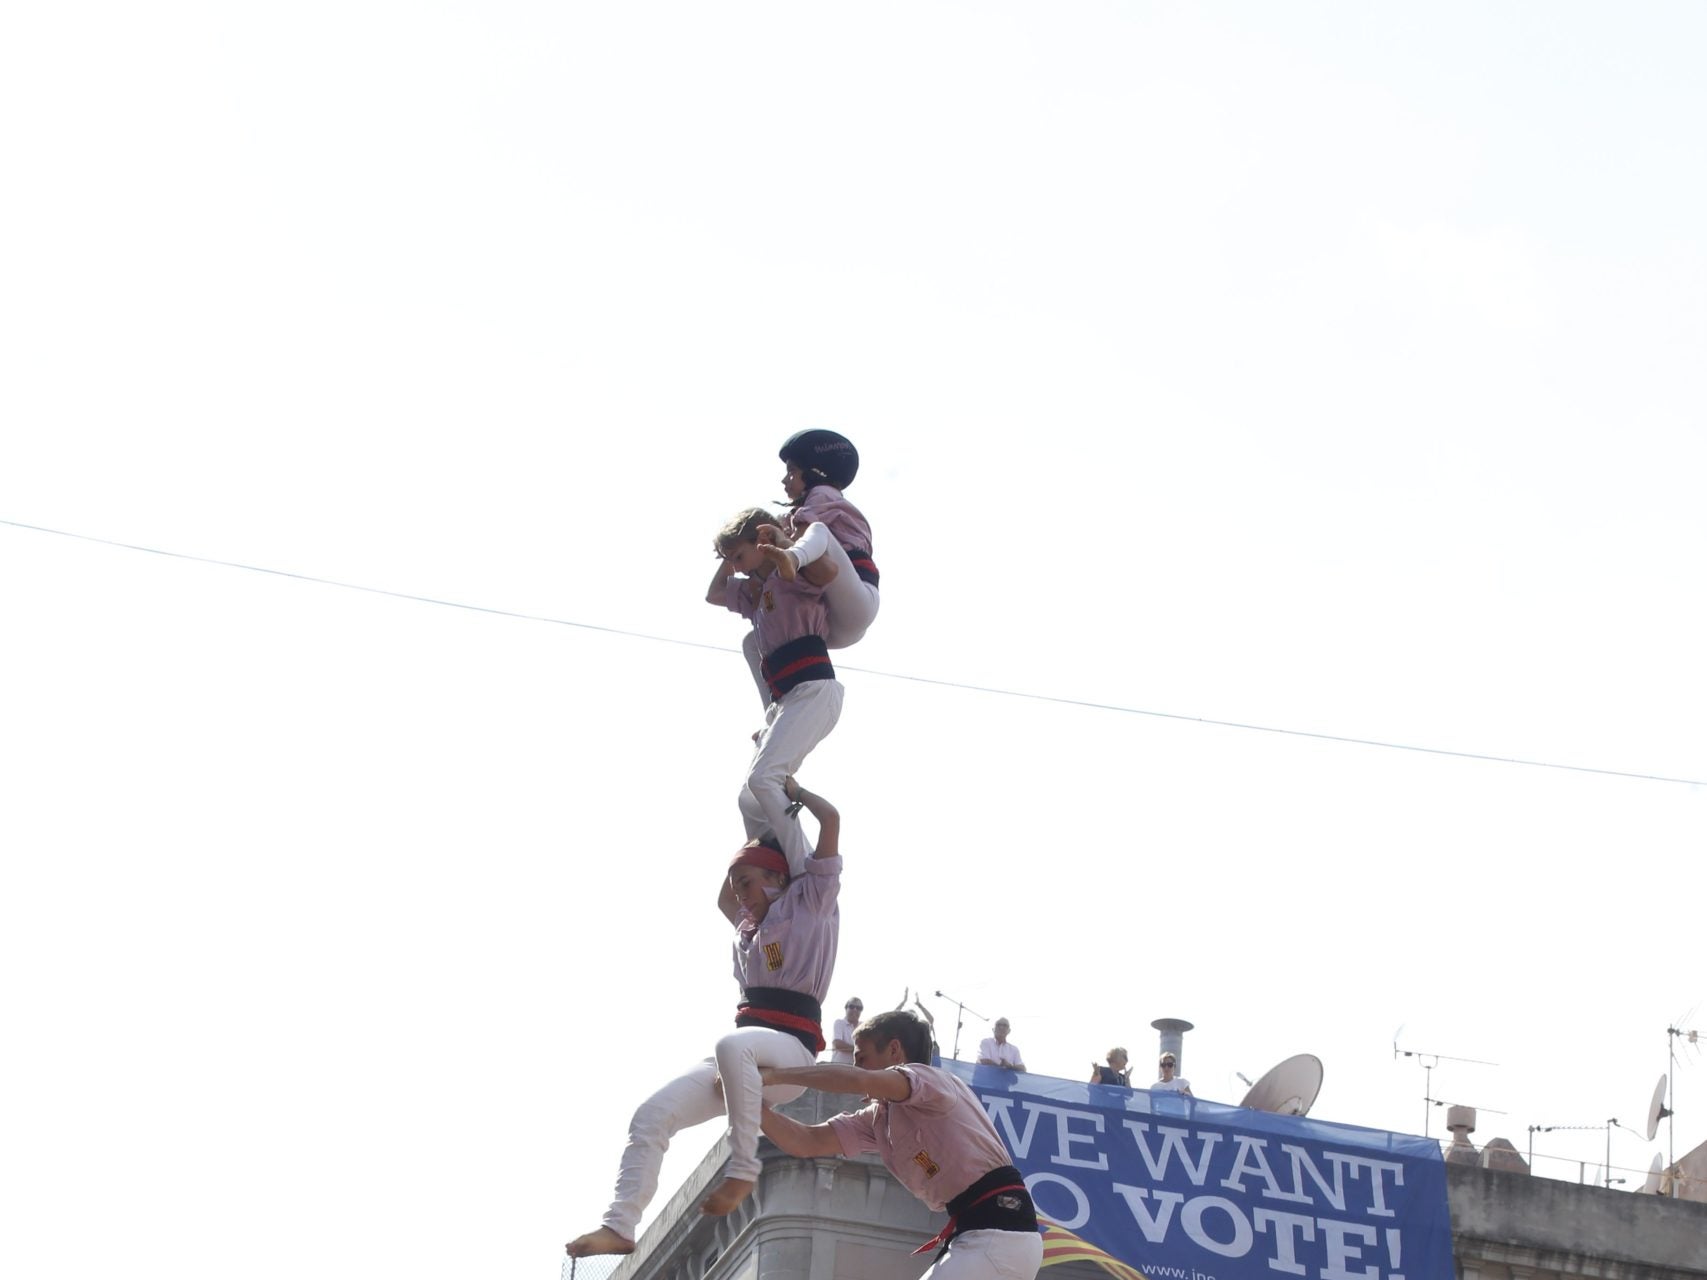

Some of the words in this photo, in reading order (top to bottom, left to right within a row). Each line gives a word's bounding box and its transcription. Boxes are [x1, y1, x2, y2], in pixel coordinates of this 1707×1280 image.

[981, 1095, 1109, 1170] WE
[1123, 1119, 1404, 1217] WANT
[1023, 1172, 1090, 1230] O
